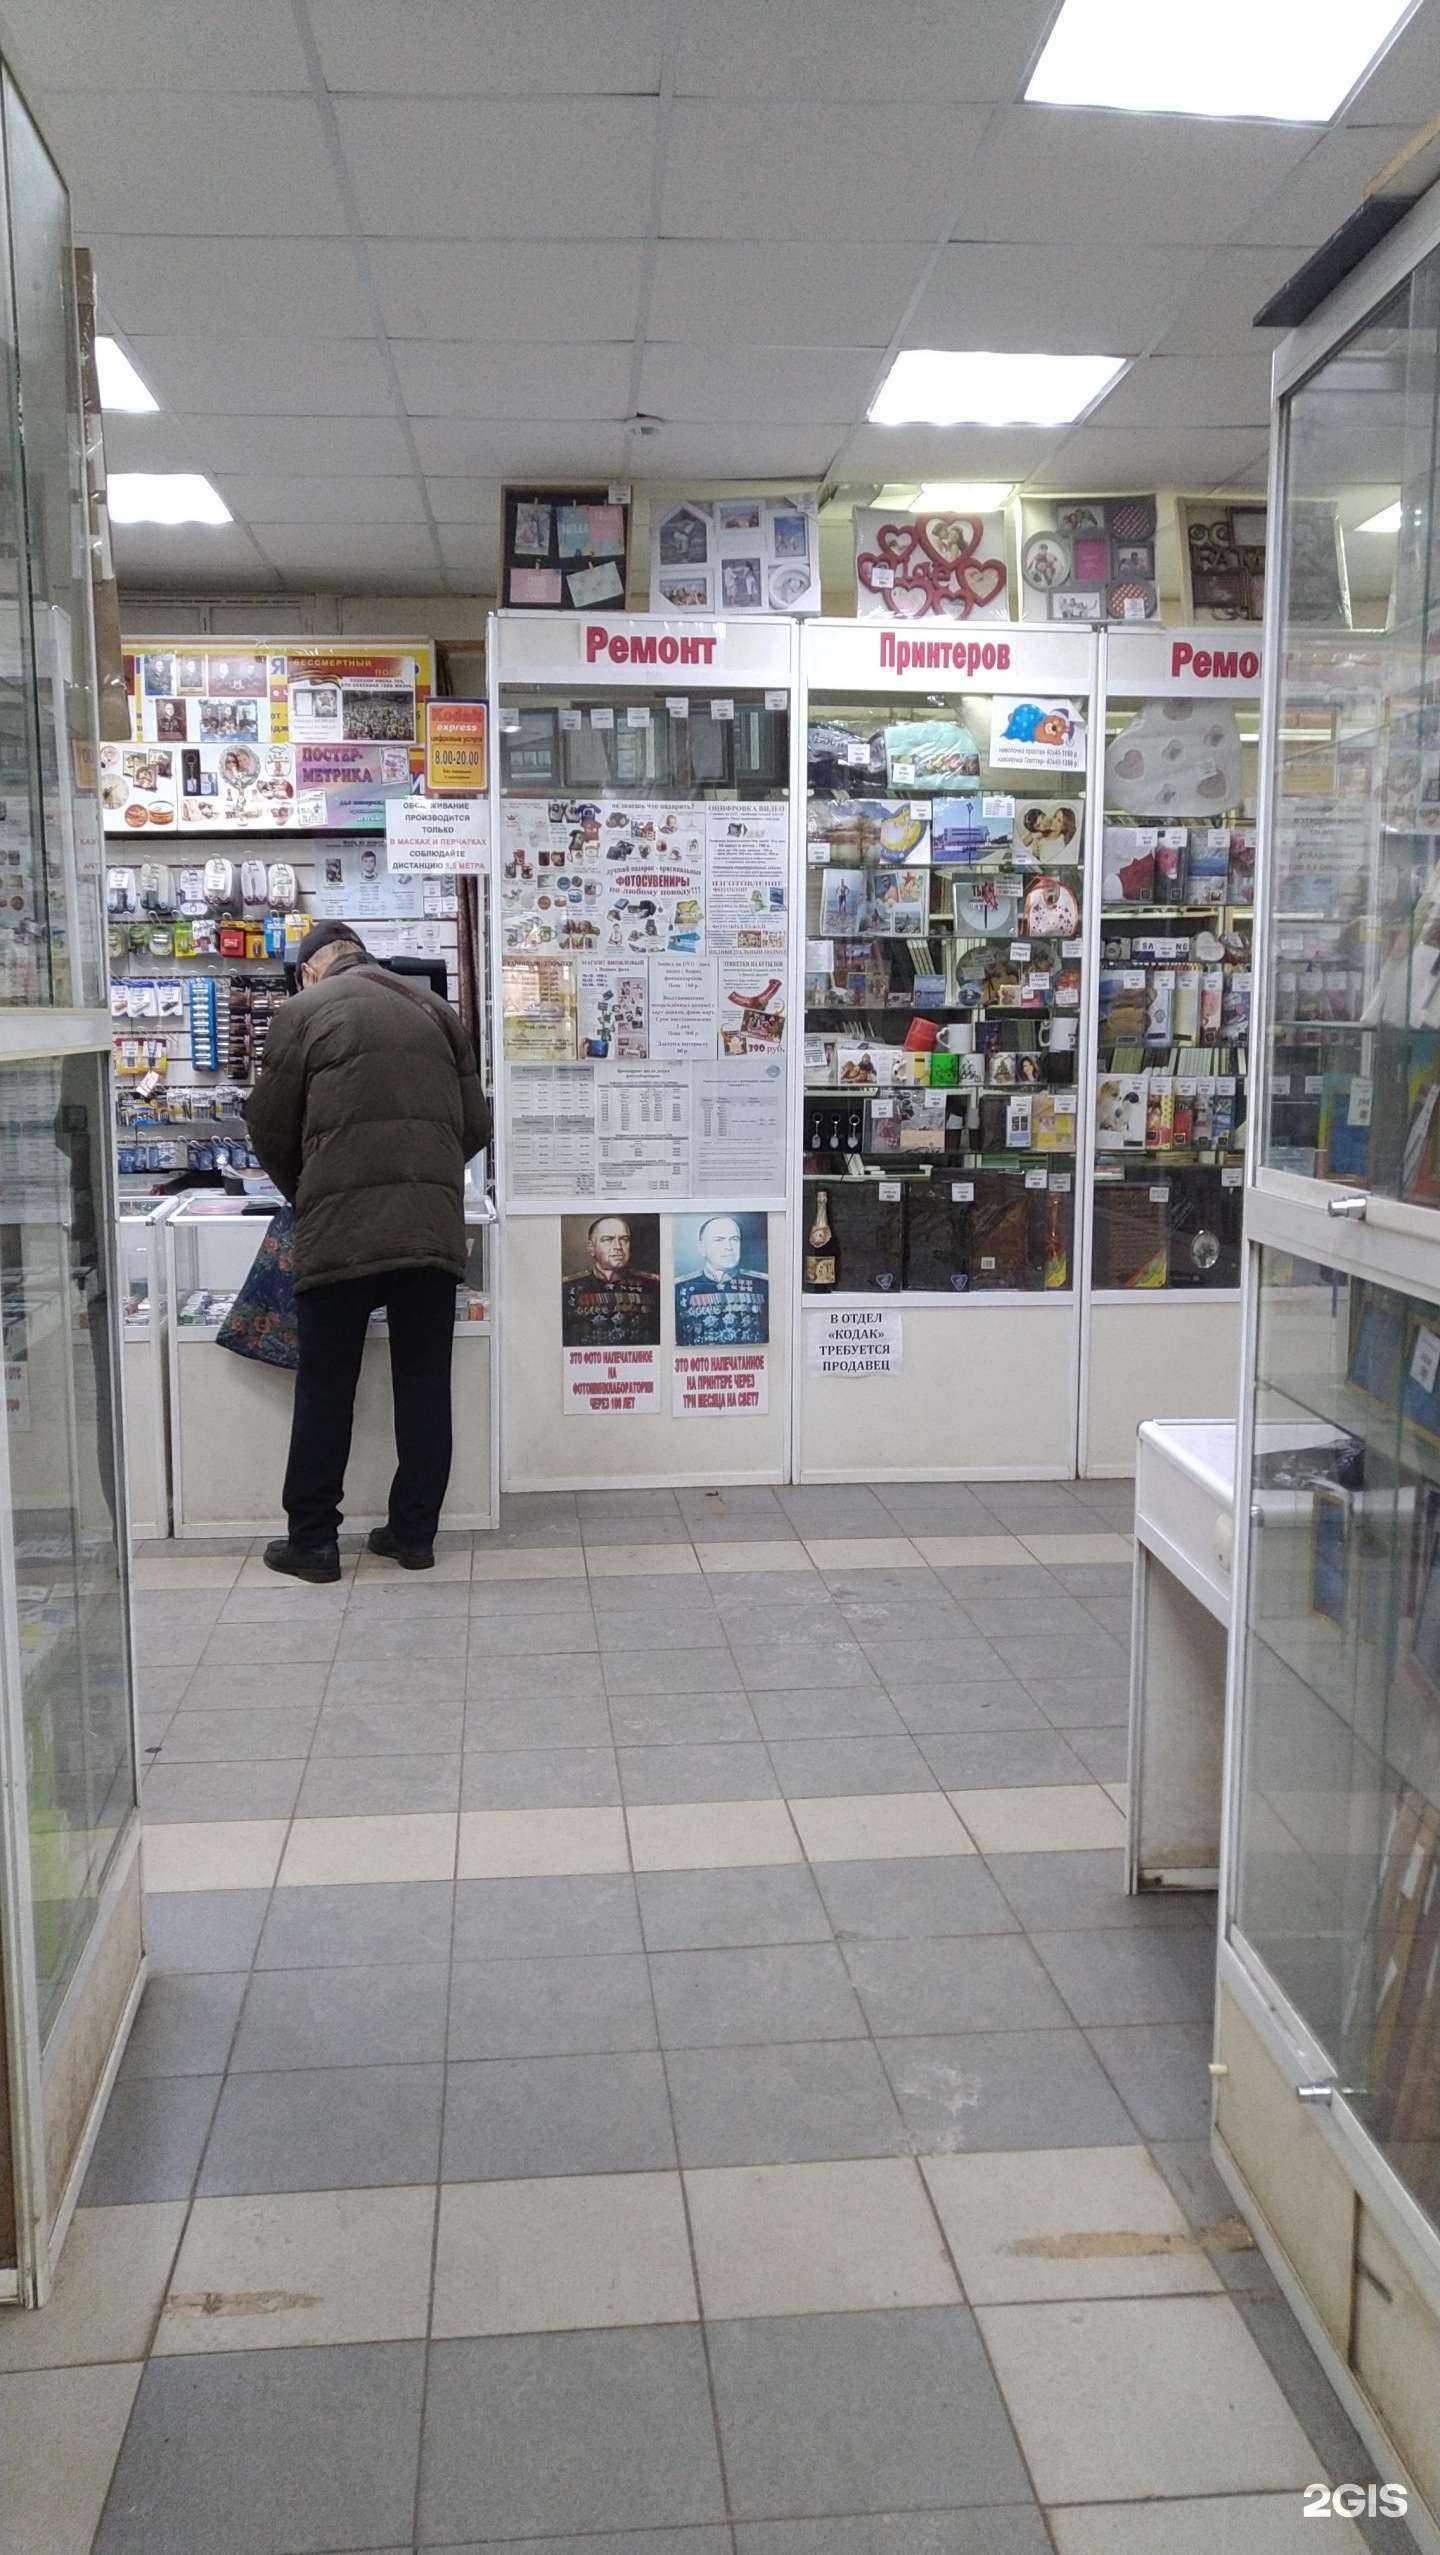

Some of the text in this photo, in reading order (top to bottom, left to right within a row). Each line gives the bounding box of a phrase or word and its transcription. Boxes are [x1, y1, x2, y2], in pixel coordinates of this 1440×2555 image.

[586, 626, 717, 664] Ремонт
[880, 632, 1011, 676] Принтеров
[1171, 642, 1263, 678] Ремо
[294, 658, 372, 668] БЕССМЕРТНЫЙ
[437, 724, 478, 733] express
[302, 747, 364, 762] ПОСТЕР-
[303, 768, 373, 783] МЕТРИКА
[403, 802, 470, 810] ОБСЖИВАНИЕ
[405, 814, 471, 822] ПРОИЗВОДИТСЯ
[422, 826, 454, 834] ТОЛЬКО
[390, 838, 395, 846] В
[397, 838, 431, 846] МАСКАХ
[433, 838, 439, 846] И
[440, 838, 487, 846] ПЕРЧАТКАХ
[410, 849, 465, 857] СОБЛЮДАЙТЕ
[616, 875, 690, 888] ФОТОСУВЕНИРЫ
[1142, 942, 1189, 950] SANG
[830, 1313, 882, 1326] В ОТДЕЛ
[828, 1329, 884, 1340] «КОДАК»
[819, 1344, 890, 1356] ТРЕБУЕТСЯ
[570, 1350, 653, 1364] ЭТО ФОТО НАПЕЧАТАННОЕ
[675, 1355, 764, 1372] ЭТО ФОТО НАПЕЧАТАННОЕ
[608, 1366, 617, 1379] НА
[823, 1360, 890, 1372] ПРОДАВЕЦ
[687, 1373, 755, 1390] НА ПРИНТЕРЕ ЧЕРЕЗ
[590, 1396, 635, 1410] ЧЕРЕЗ 100 ЛЕТ
[683, 1391, 759, 1410] ТРИ МЕСЯЦА НА СВЕТУ
